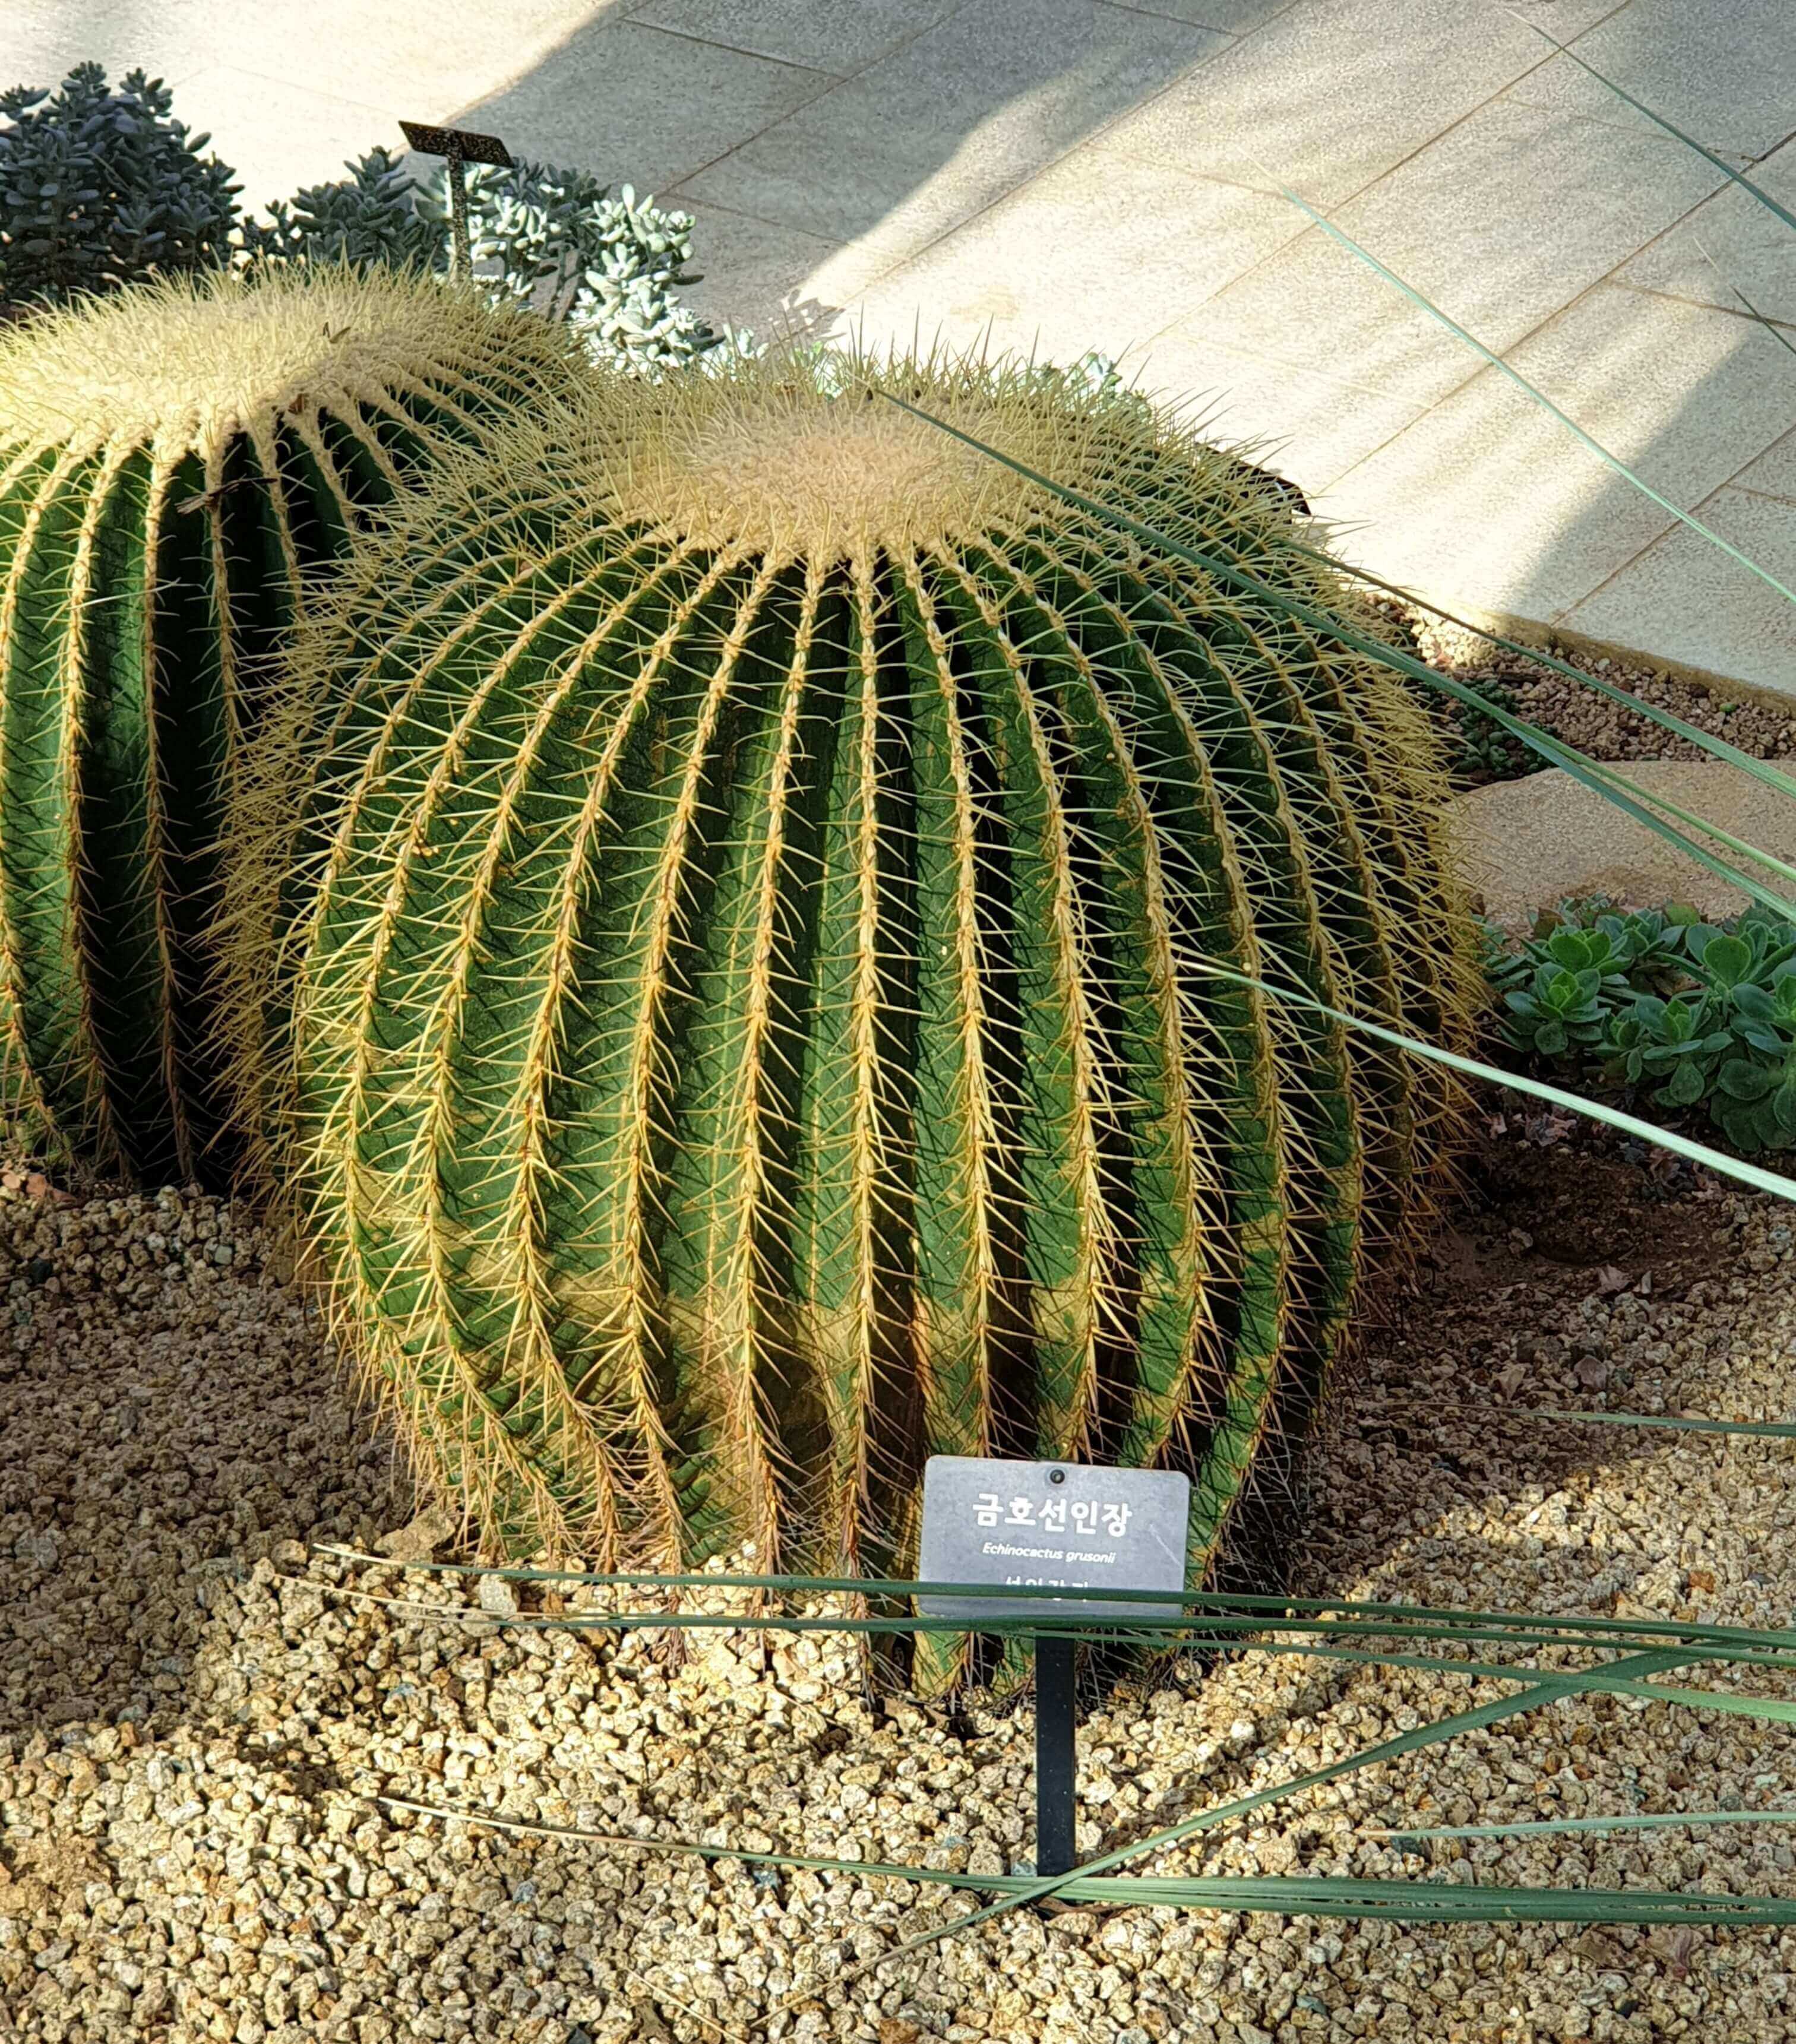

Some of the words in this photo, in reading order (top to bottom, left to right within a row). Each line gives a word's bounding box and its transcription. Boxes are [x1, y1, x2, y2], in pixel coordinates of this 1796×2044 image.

[972, 1493, 1133, 1537] 금호선인장
[982, 1542, 1064, 1559] Echinocactus
[1065, 1551, 1117, 1564] grusonii
